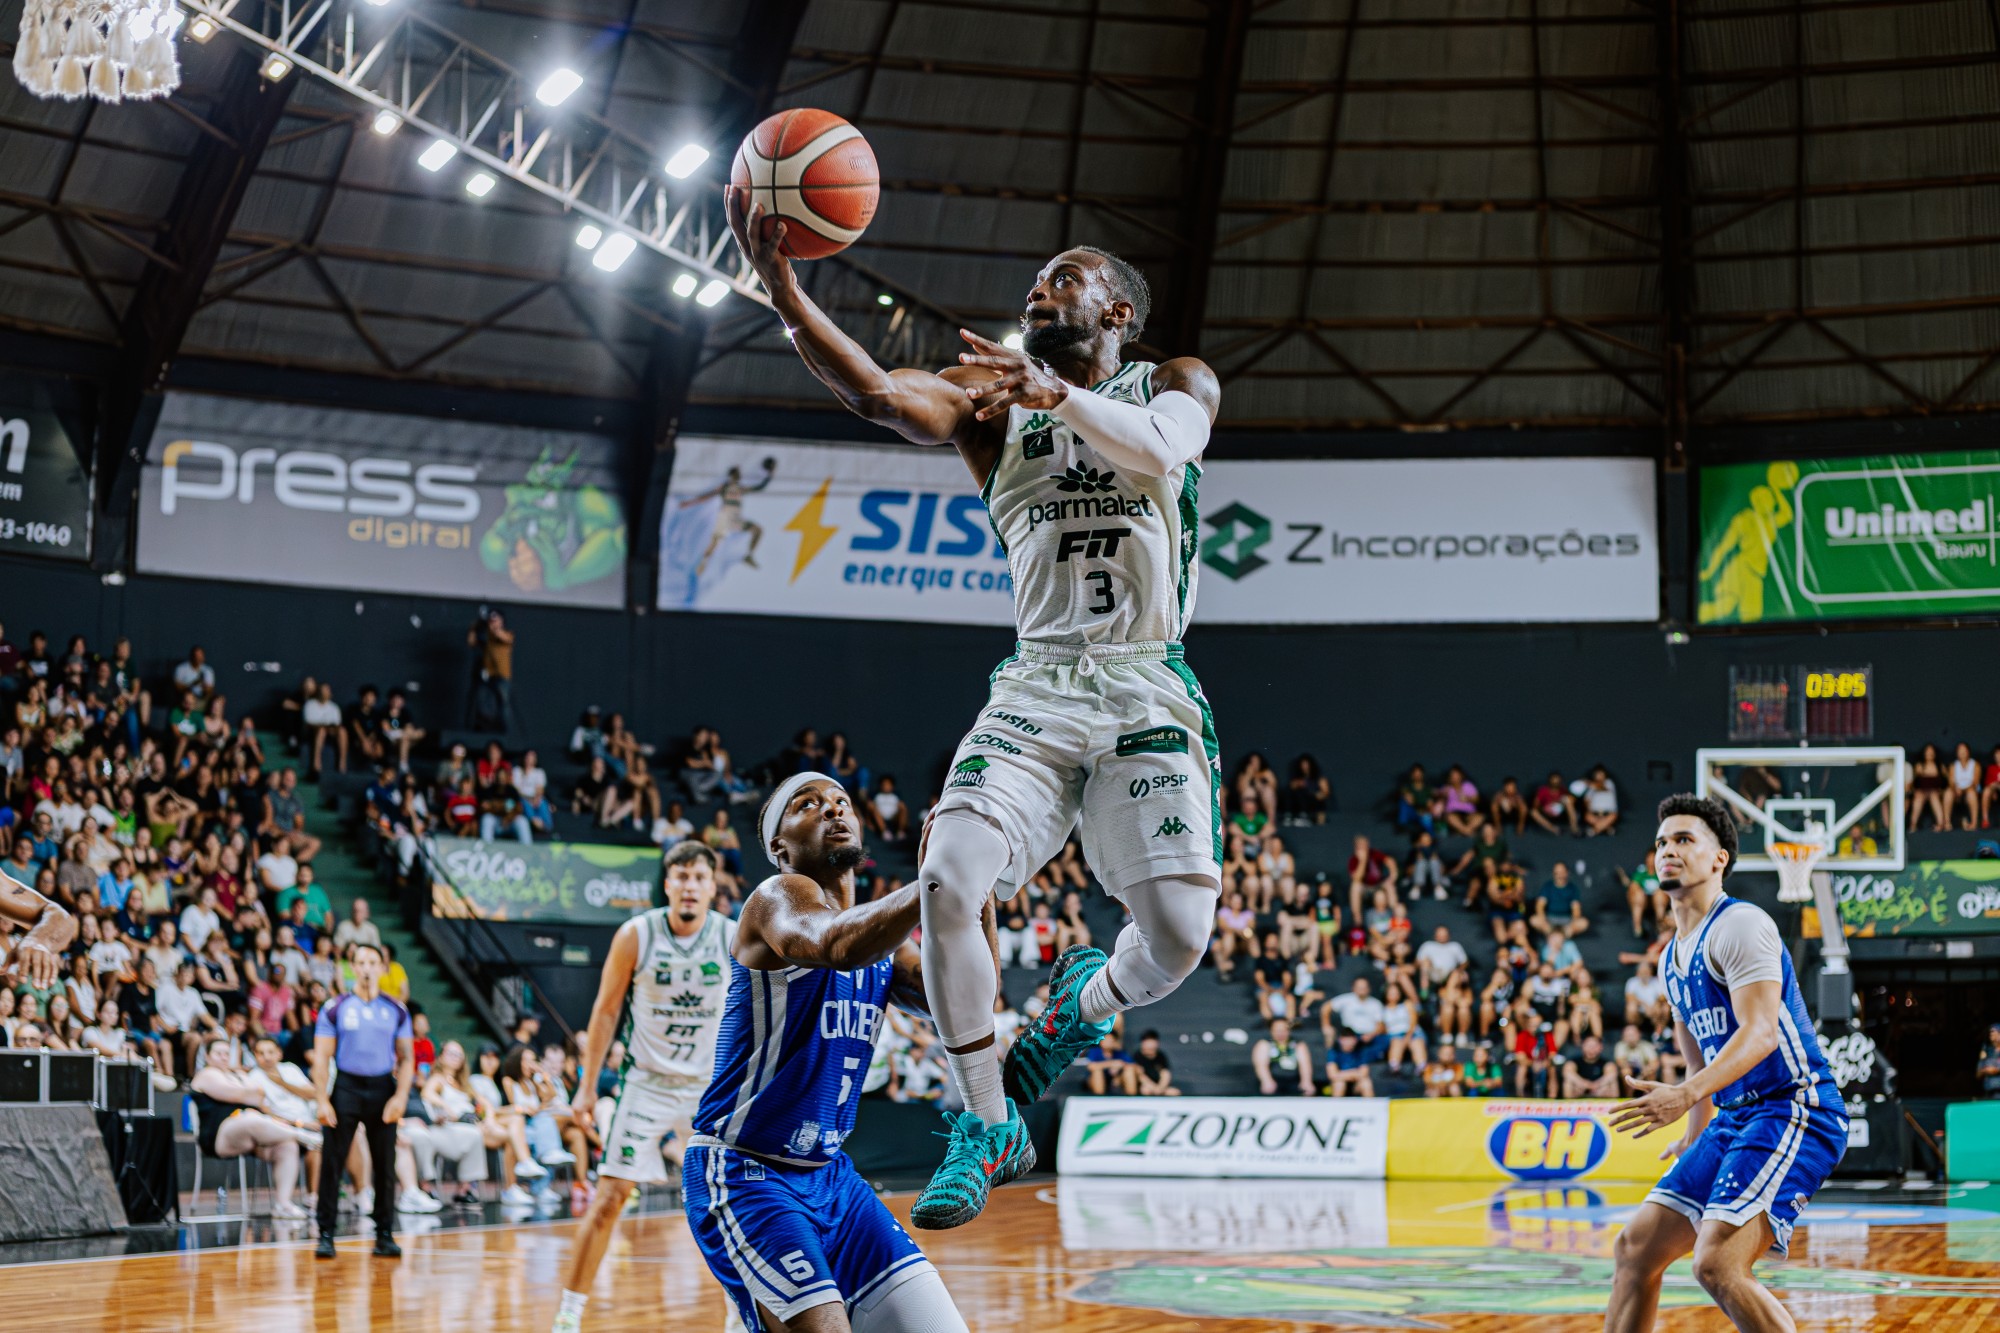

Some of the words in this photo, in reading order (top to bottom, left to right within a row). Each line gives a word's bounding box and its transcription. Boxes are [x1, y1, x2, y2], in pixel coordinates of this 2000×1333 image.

[160, 440, 481, 522] press
[850, 490, 1008, 560] SIS
[1028, 494, 1153, 531] parmalat
[1825, 500, 1986, 539] Unimed
[348, 516, 471, 549] digital
[1286, 523, 1324, 564] Z
[1331, 529, 1640, 563] Incorporações
[1934, 541, 1986, 560] Bauru
[843, 563, 953, 594] energia
[1084, 570, 1116, 615] 3
[1805, 673, 1867, 698] 03:05
[1152, 774, 1188, 789] SPSP
[668, 1041, 696, 1061] 77
[1157, 1110, 1361, 1152] ZOPONE
[1502, 1120, 1595, 1170] BH
[779, 1250, 815, 1282] 5
